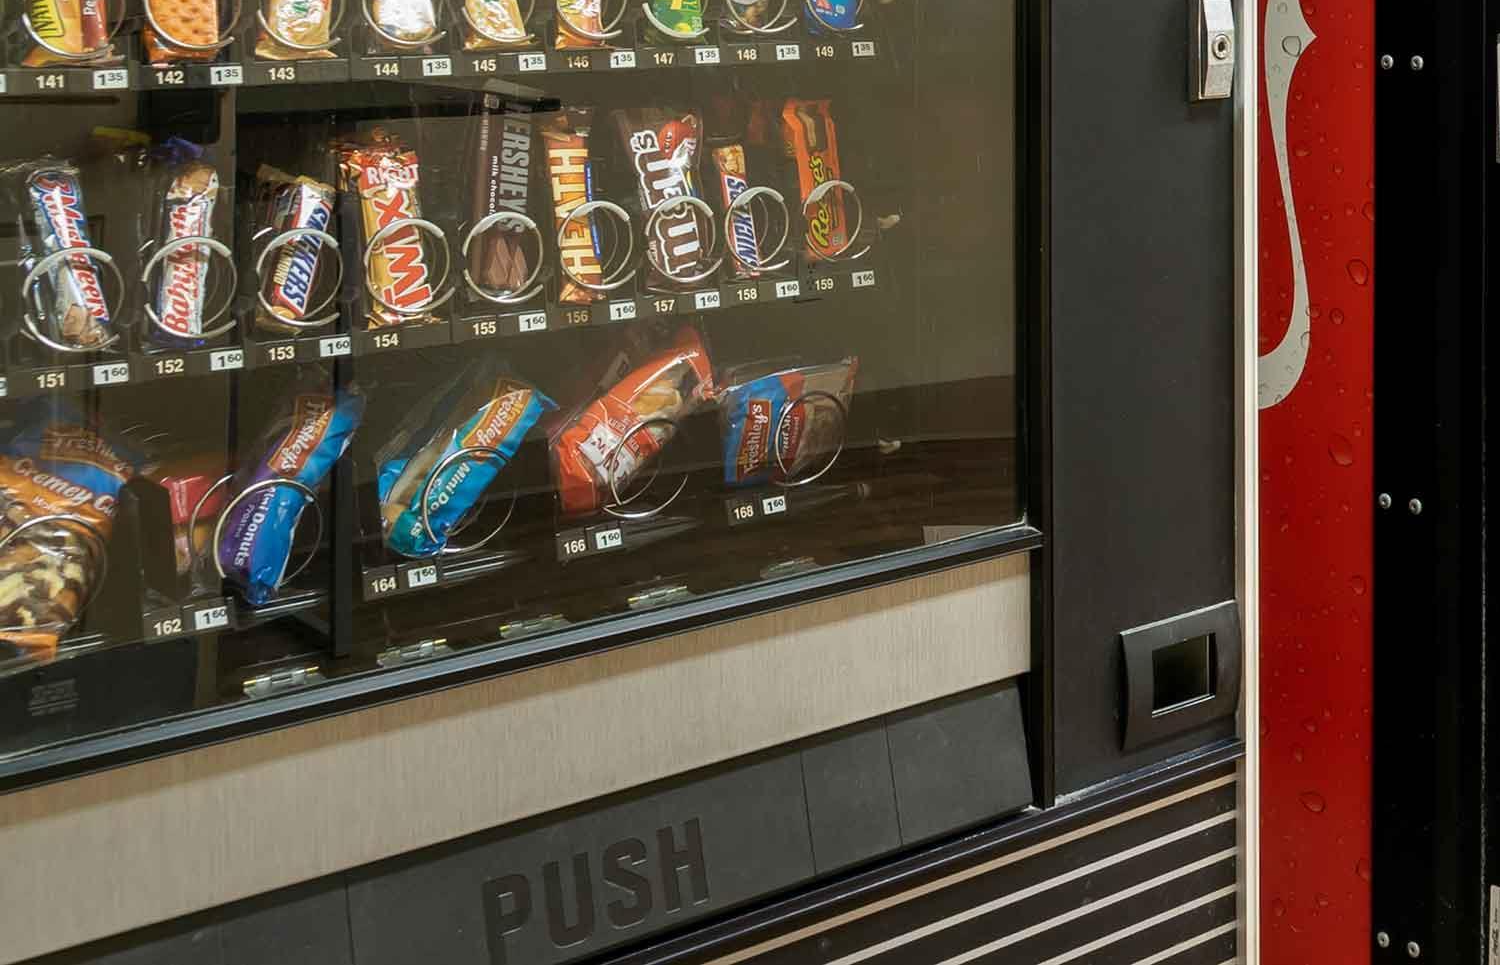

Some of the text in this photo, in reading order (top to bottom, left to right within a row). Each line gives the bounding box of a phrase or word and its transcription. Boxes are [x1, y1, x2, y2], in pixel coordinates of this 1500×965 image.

[653, 53, 674, 65] 147
[736, 49, 757, 61] 148
[815, 46, 834, 58] 149
[374, 63, 400, 76] 144
[472, 60, 497, 72] 145
[567, 56, 590, 68] 146
[155, 70, 184, 85] 142
[268, 67, 296, 81] 143
[36, 75, 65, 89] 141
[488, 155, 499, 217] milk chocol
[809, 155, 832, 247] Reee's
[548, 148, 602, 275] HEATH
[727, 176, 760, 268] SNICKRS
[374, 191, 432, 310] TWIX
[815, 278, 834, 290] 159
[162, 264, 195, 333] Baby
[737, 289, 758, 301] 158
[654, 300, 675, 312] 157
[566, 310, 589, 324] 156
[472, 321, 496, 335] 155
[374, 333, 399, 347] 154
[269, 347, 295, 361] 153
[155, 359, 184, 374] 152
[37, 374, 65, 388] 151
[472, 389, 525, 454] Freshley
[744, 403, 769, 474] Freshley's
[410, 462, 471, 538] Mini Dots
[733, 505, 754, 520] 168
[234, 512, 267, 568] Donuts
[564, 540, 587, 555] 166
[371, 577, 396, 593] 164
[154, 619, 182, 636] 162
[482, 817, 713, 963] PUSH
